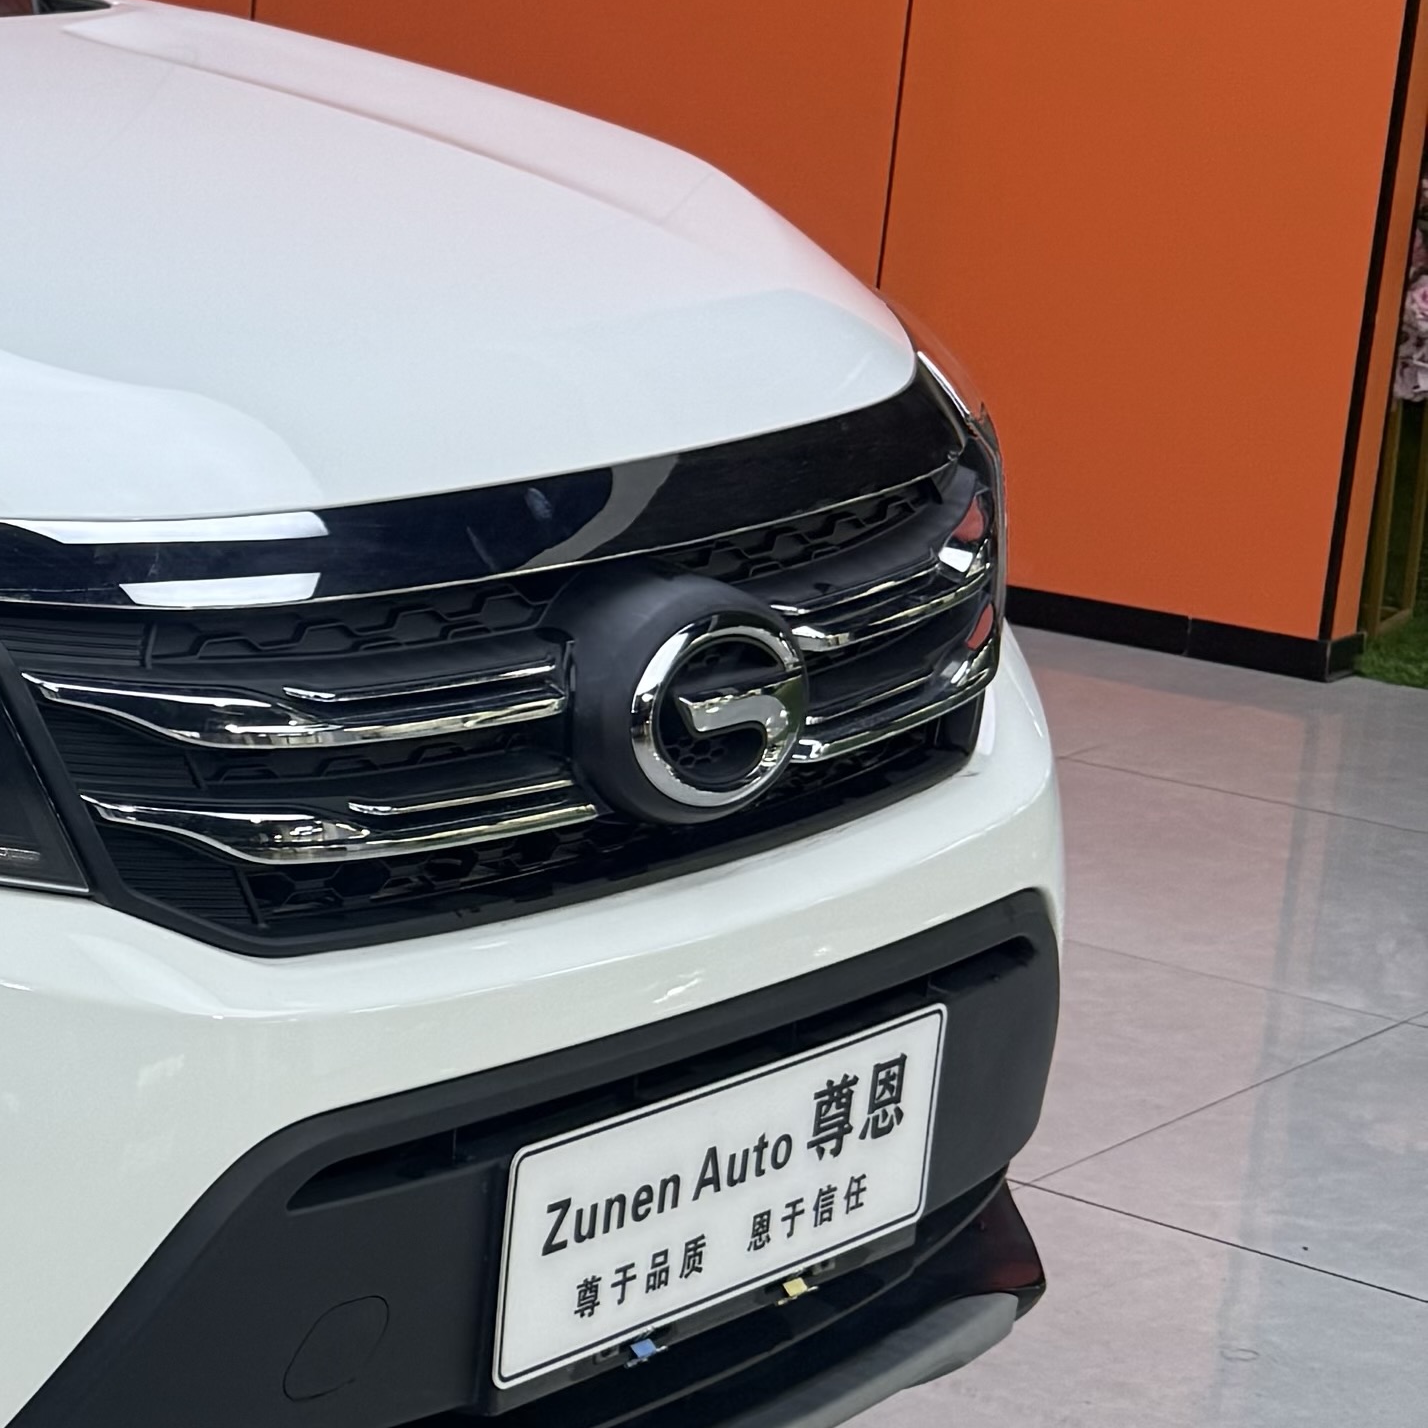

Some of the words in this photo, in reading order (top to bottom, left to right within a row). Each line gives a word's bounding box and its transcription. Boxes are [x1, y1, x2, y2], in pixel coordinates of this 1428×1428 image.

[541, 1173, 682, 1257] Zunen
[691, 1146, 794, 1202] Auto
[806, 1053, 909, 1161] 尊恩
[573, 1233, 707, 1319] 尊于品质
[747, 1173, 868, 1252] 恩于信任
